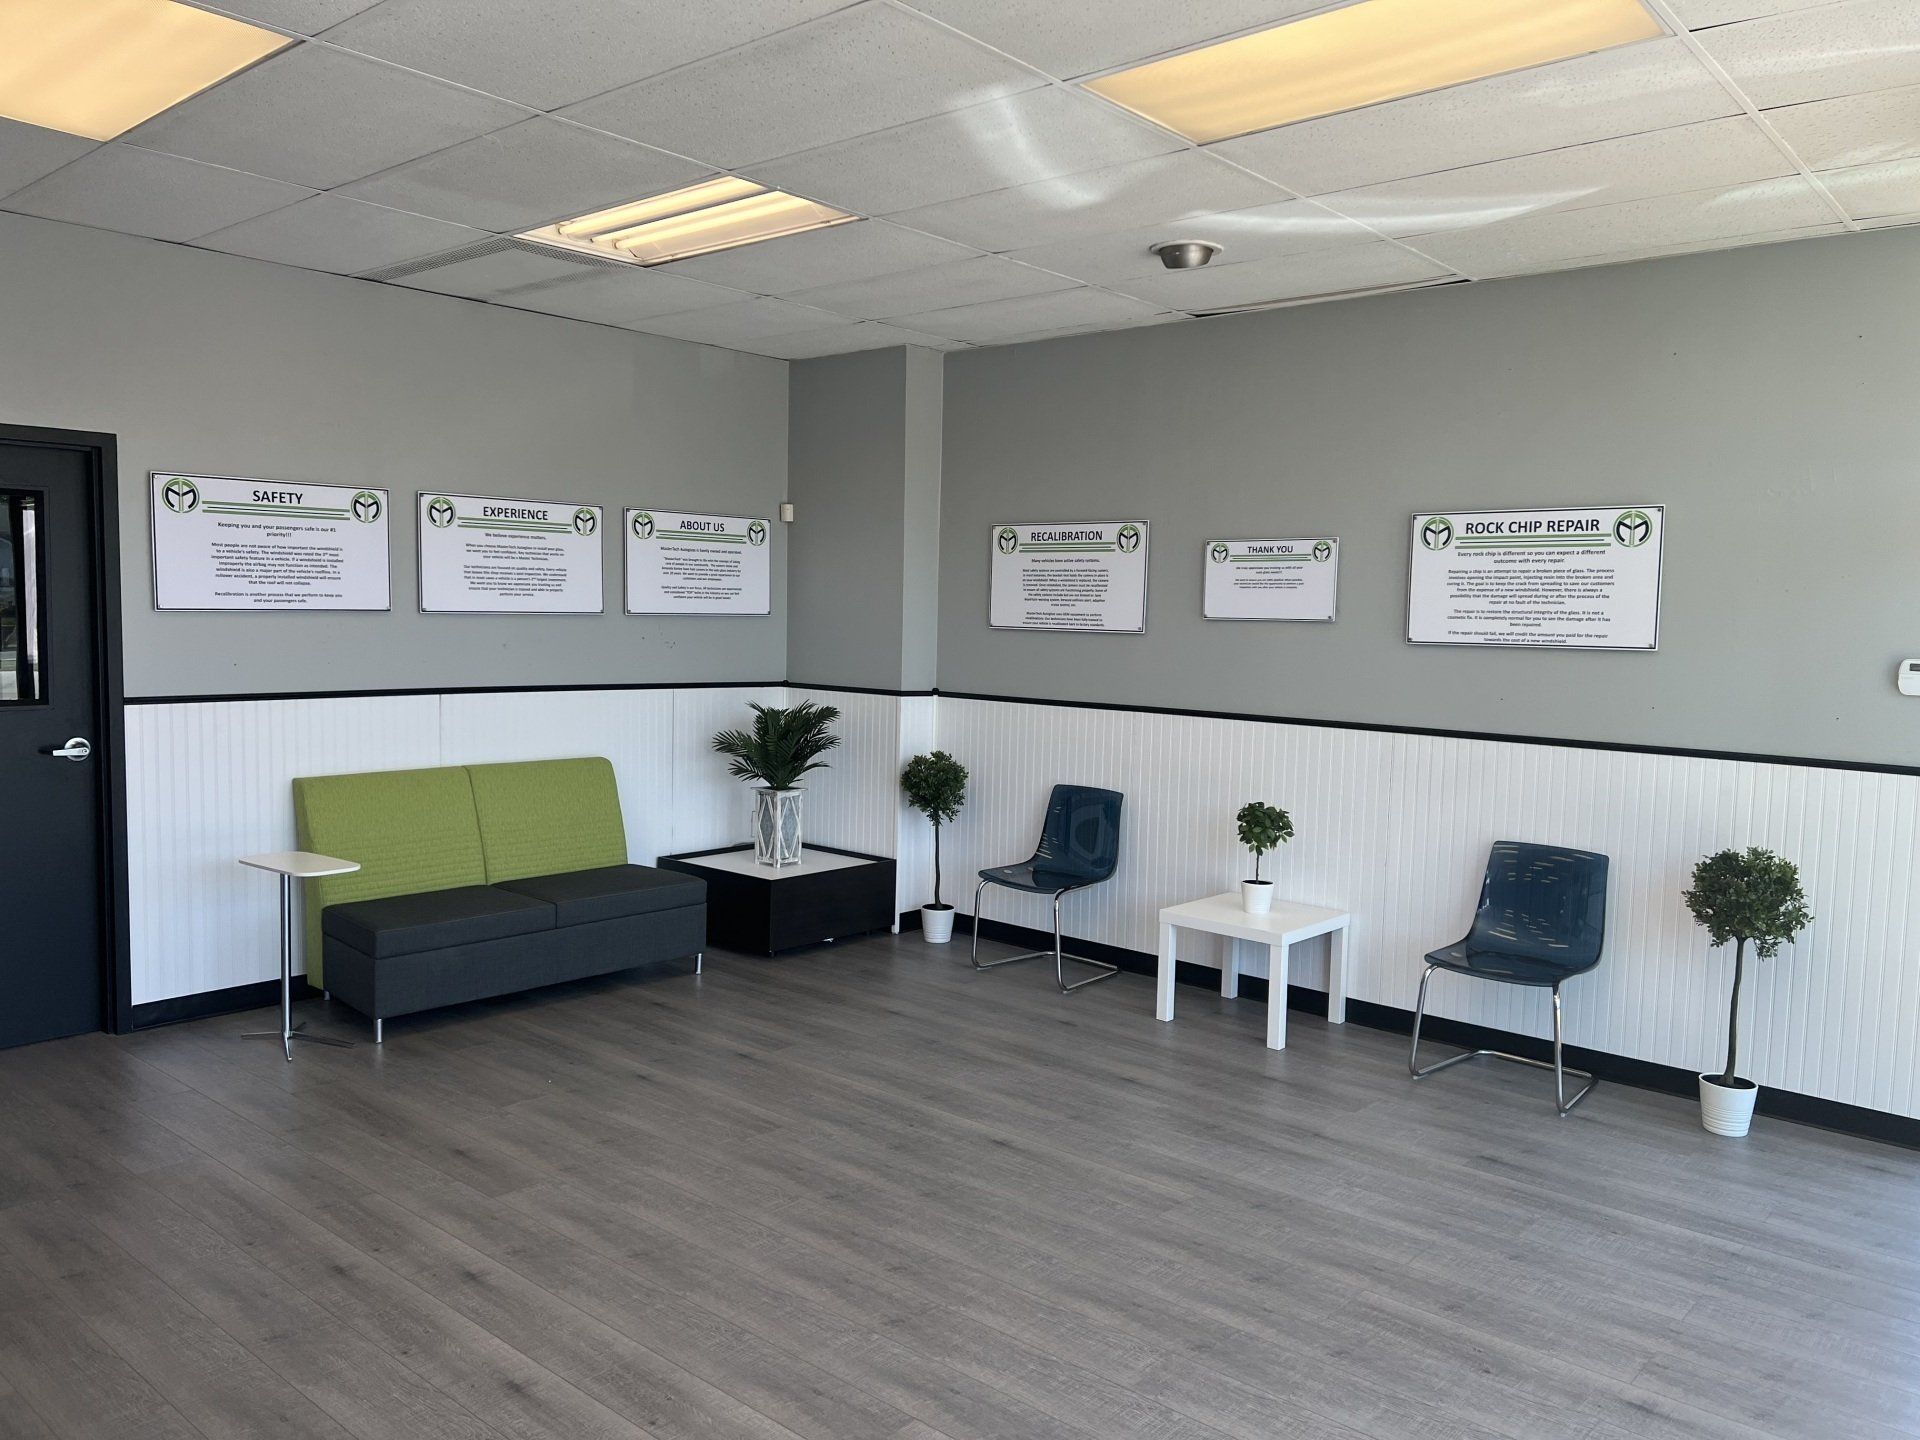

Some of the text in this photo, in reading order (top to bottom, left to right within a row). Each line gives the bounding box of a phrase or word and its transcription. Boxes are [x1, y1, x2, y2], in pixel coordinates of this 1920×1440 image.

[252, 490, 303, 504] SAFETY
[483, 506, 548, 520] EXPERIENCE
[680, 520, 725, 532] ABOUT US
[1466, 519, 1600, 534] ROCK CHIP REPAIR
[1030, 530, 1103, 542] RECALIBRATION
